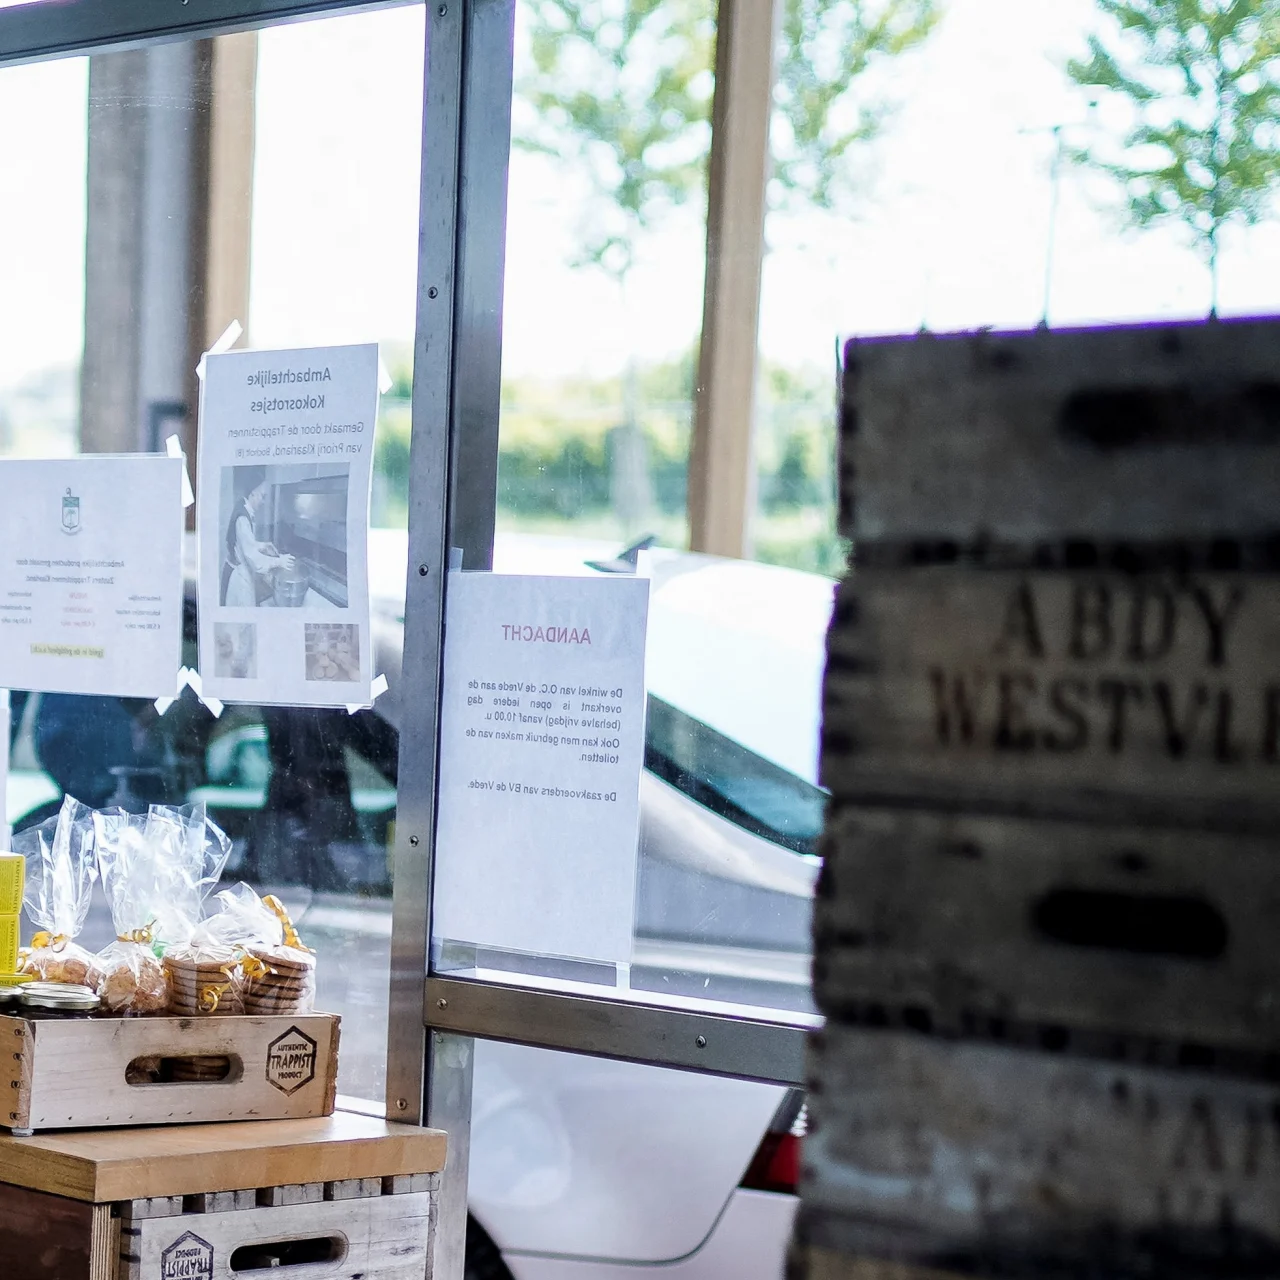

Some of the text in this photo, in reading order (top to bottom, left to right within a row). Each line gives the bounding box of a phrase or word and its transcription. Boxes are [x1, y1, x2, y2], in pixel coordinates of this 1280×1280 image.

[928, 664, 1280, 765] WESTVL
[277, 1043, 308, 1051] AUTHENTIC
[271, 1053, 313, 1070] TRAPPIST
[166, 1258, 209, 1278] TRAPPIST
